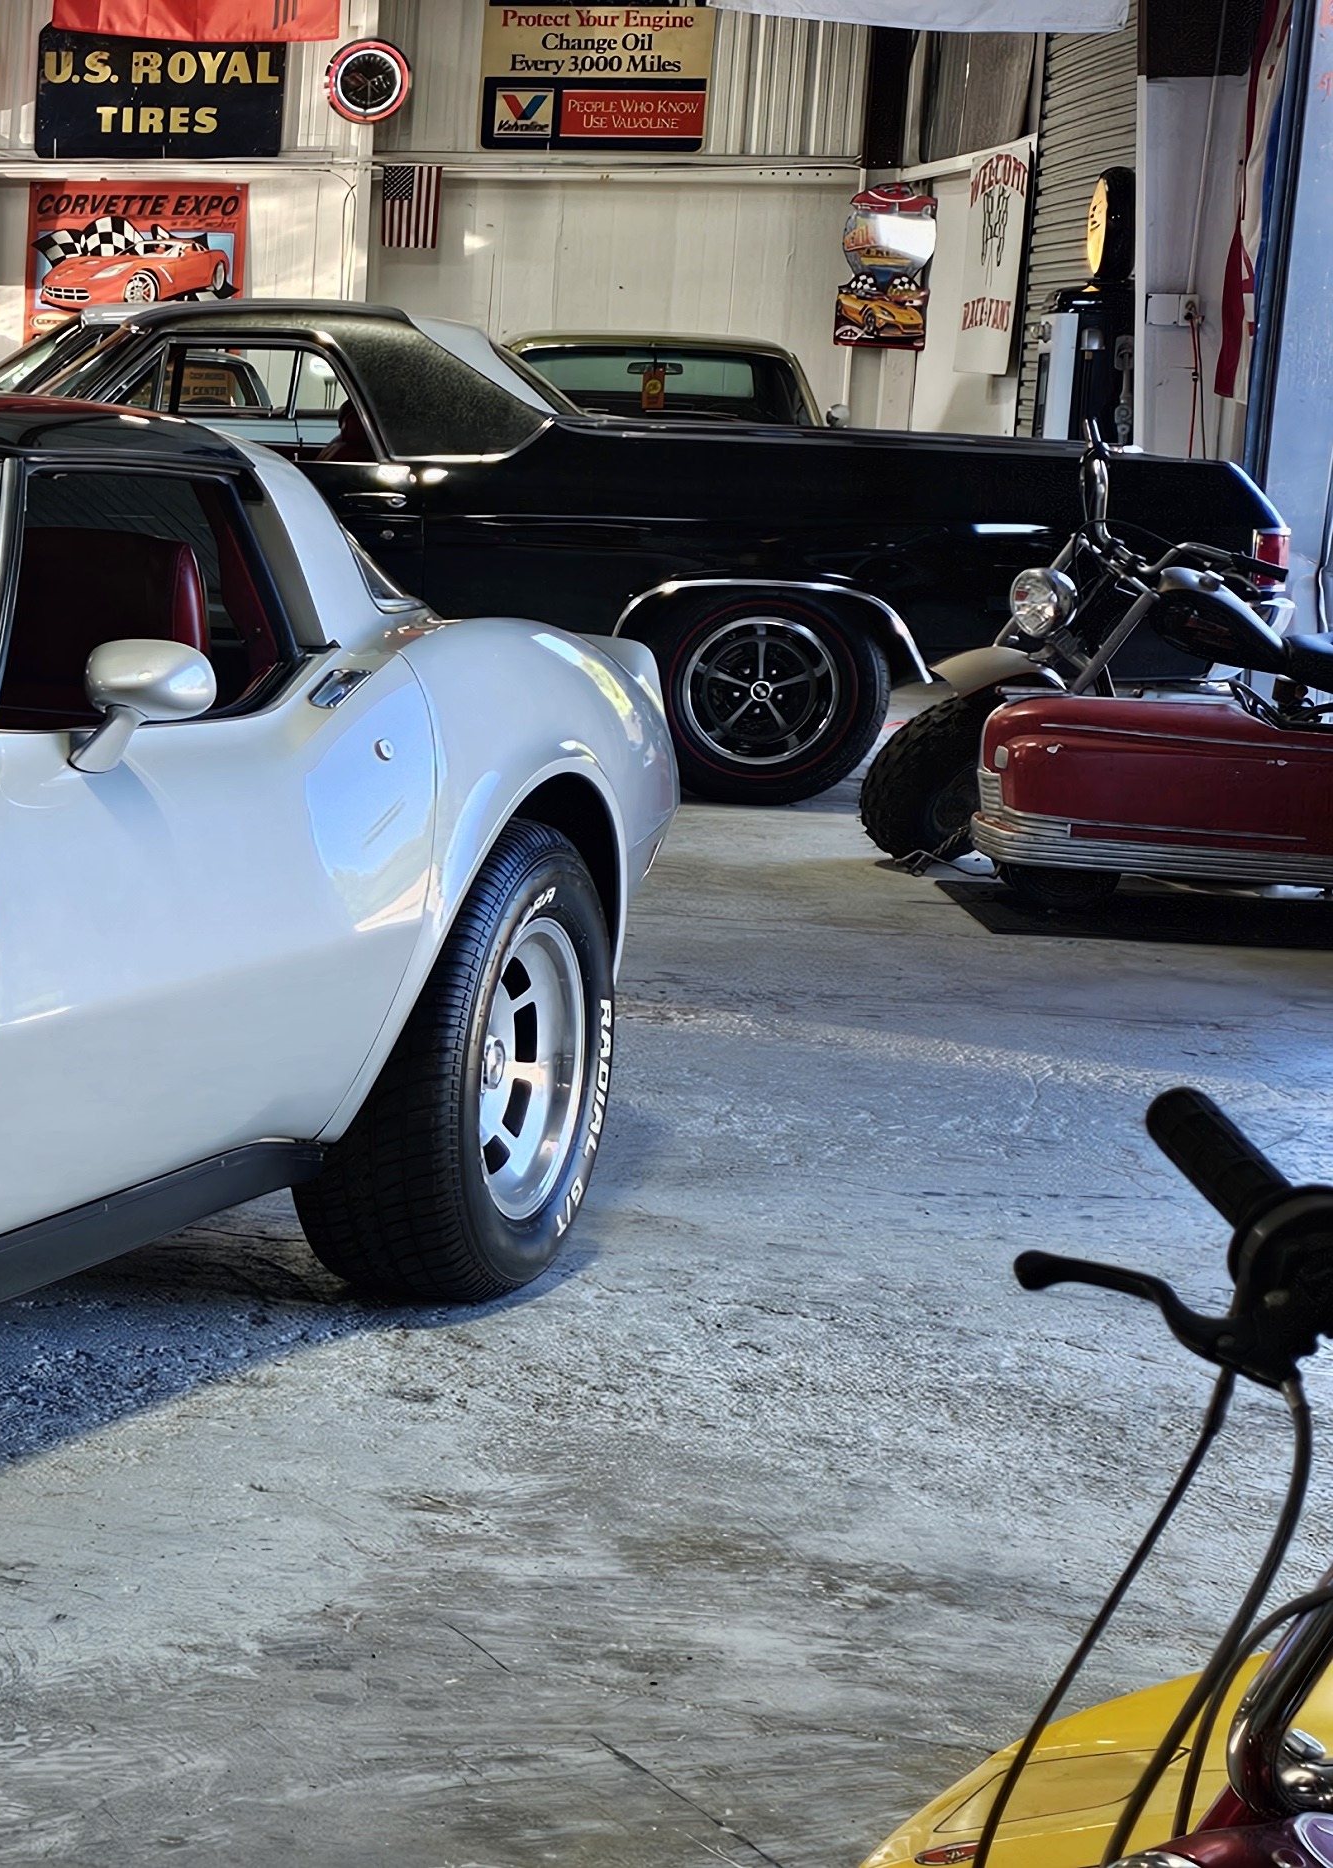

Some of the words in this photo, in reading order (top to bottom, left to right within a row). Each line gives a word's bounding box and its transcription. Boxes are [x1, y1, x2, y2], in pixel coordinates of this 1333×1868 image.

[502, 10, 570, 27] Protect
[576, 10, 619, 27] Your
[624, 10, 694, 31] Engine
[542, 33, 618, 53] Change
[622, 33, 653, 51] Oil
[44, 51, 119, 84] U.S.
[131, 51, 279, 85] ROYAL
[510, 54, 565, 75] Every
[568, 55, 622, 75] 3,000
[626, 55, 681, 73] Miles
[567, 99, 617, 113] PEOPLE
[620, 99, 654, 113] WHO
[657, 99, 699, 114] KNOW
[96, 106, 218, 134] TIRES
[497, 119, 549, 133] Valvoline
[583, 114, 608, 128] USE
[612, 115, 680, 129] VALVOLINE
[970, 154, 1029, 208] WELCOME
[37, 194, 169, 216] CORVETTE
[171, 195, 240, 217] EXPO
[584, 999, 612, 1158] RADIAL
[556, 1175, 584, 1237] G/T
